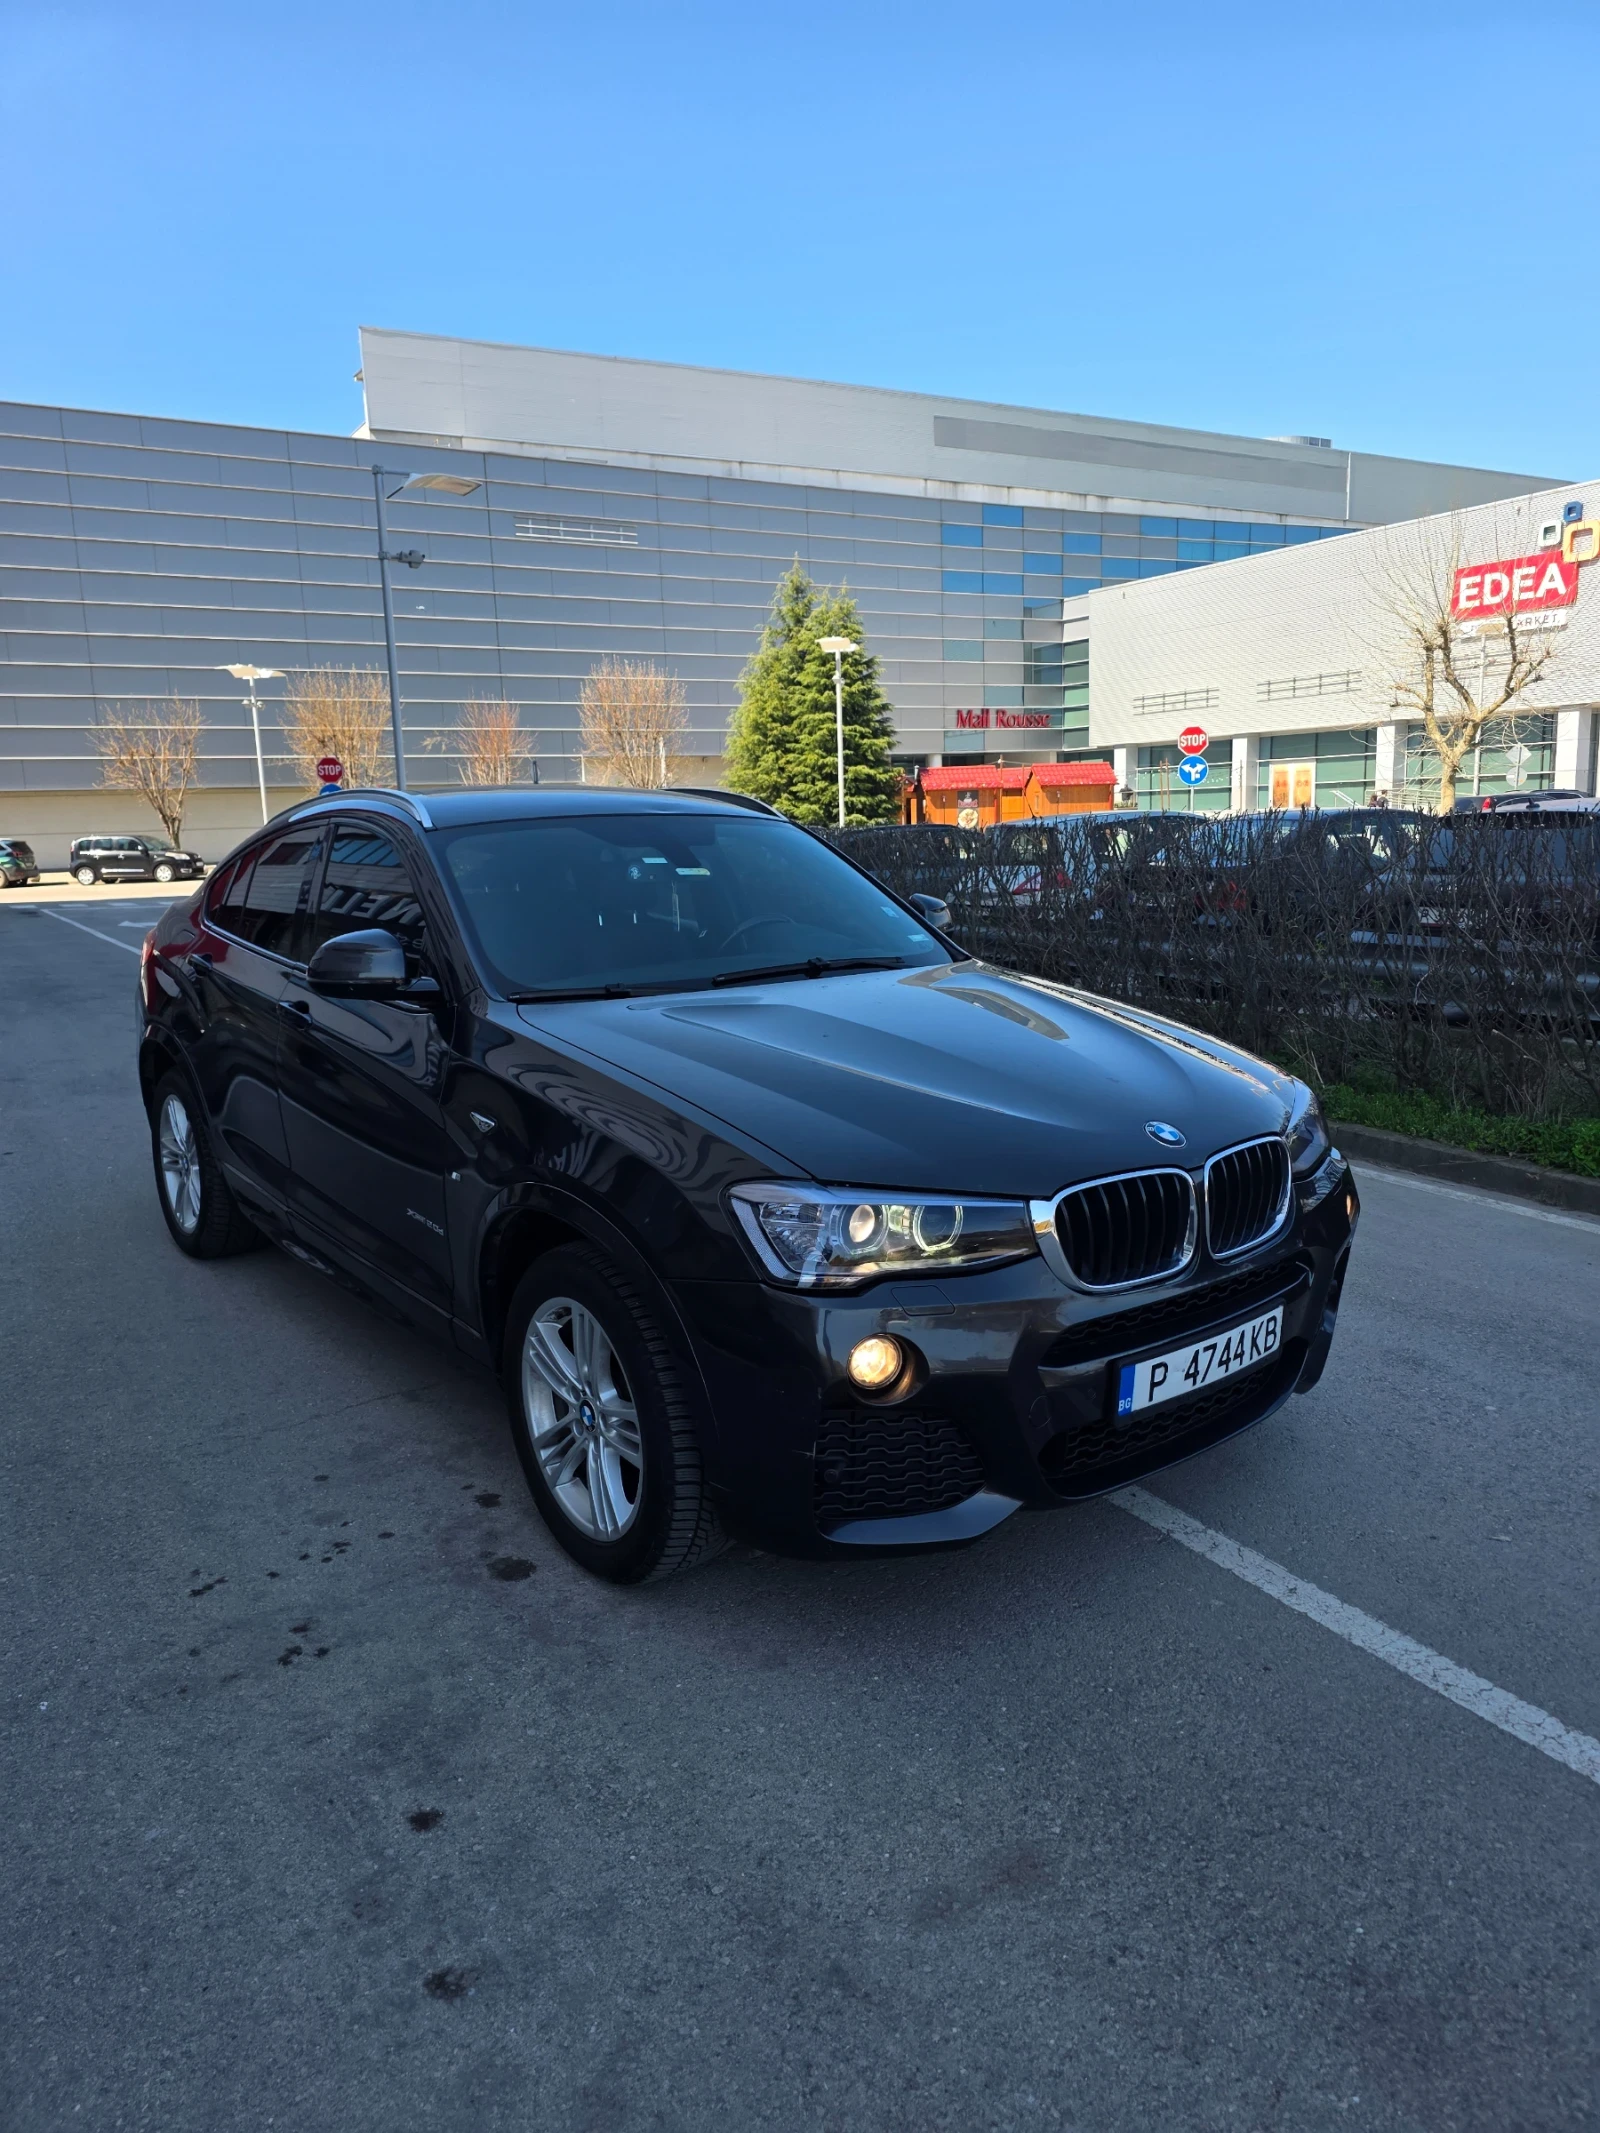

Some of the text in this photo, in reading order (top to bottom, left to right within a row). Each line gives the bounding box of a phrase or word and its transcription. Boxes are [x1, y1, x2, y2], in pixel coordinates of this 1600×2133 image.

[1459, 563, 1567, 609] EDEA
[956, 709, 1051, 728] Mall Rousse
[1180, 734, 1206, 747] STOP
[318, 764, 342, 776] STOP
[1148, 1361, 1168, 1402] P
[1118, 1398, 1131, 1411] BG
